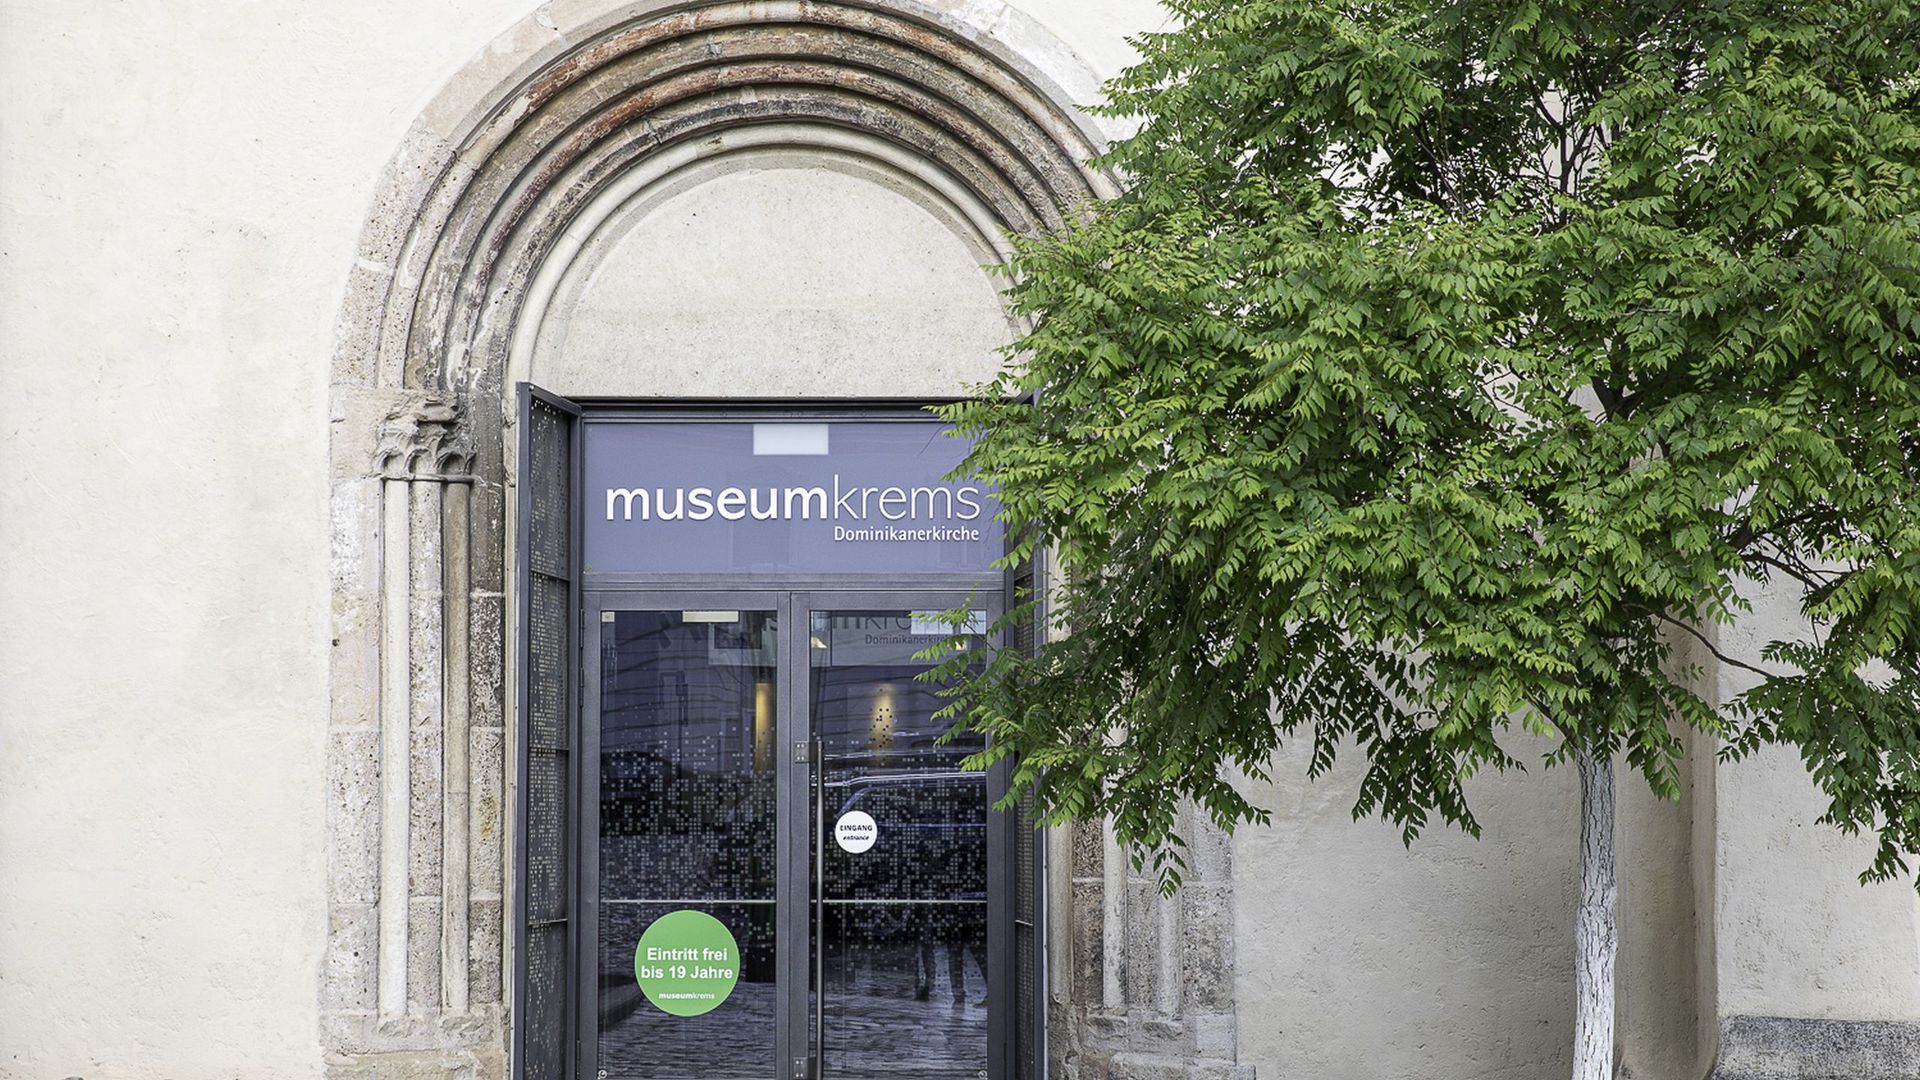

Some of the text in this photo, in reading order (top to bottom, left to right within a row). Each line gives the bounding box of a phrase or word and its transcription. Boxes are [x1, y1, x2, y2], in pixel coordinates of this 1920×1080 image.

[606, 474, 981, 521] museumkrems
[834, 526, 980, 541] Dominikanerkirche
[840, 824, 873, 832] EINGANG
[647, 947, 728, 961] Eintritt frei
[641, 965, 733, 979] bis 19 Jahre
